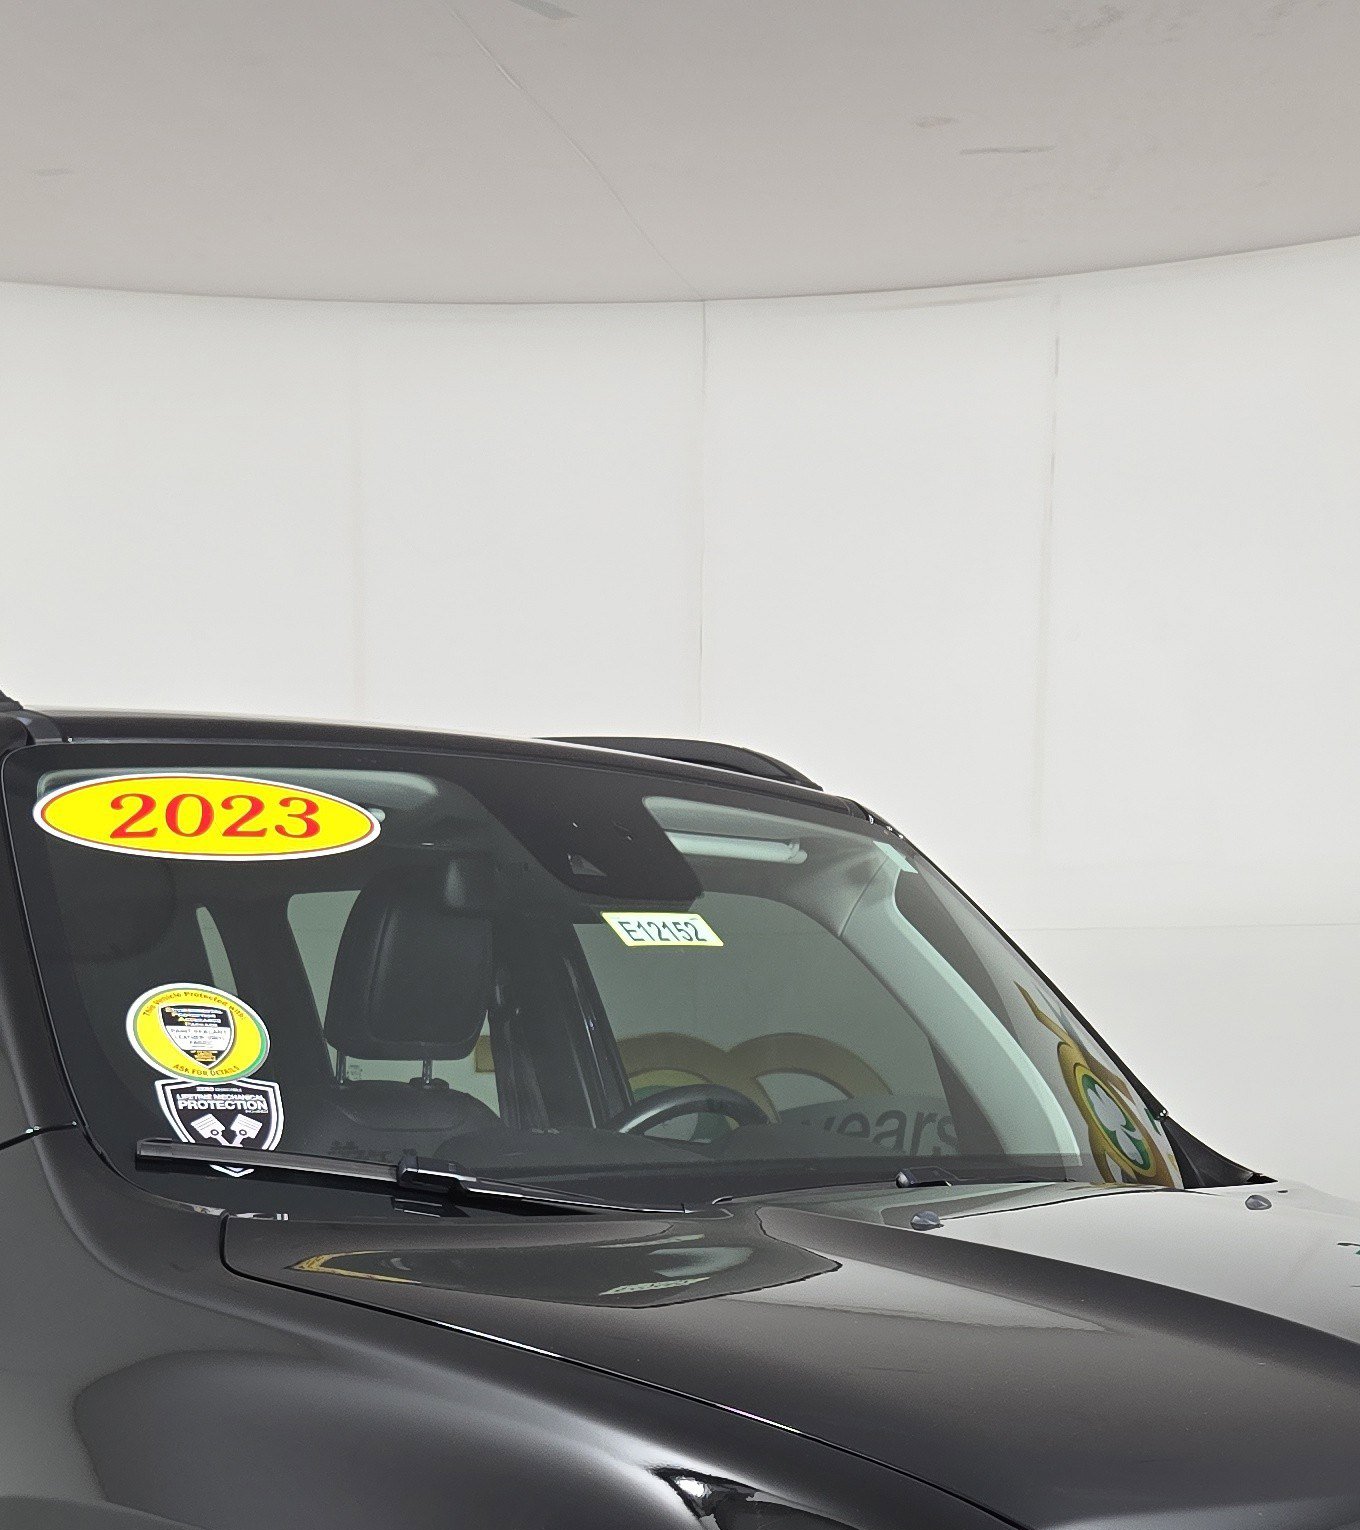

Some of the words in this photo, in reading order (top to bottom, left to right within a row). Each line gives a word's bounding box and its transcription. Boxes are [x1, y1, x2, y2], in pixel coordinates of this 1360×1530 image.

[109, 794, 322, 840] 2023
[617, 920, 708, 942] E12152
[173, 1064, 190, 1075] ASK
[191, 1067, 208, 1076] FOR
[209, 1065, 240, 1077] DETAILS
[177, 1099, 269, 1111] PROTECTION
